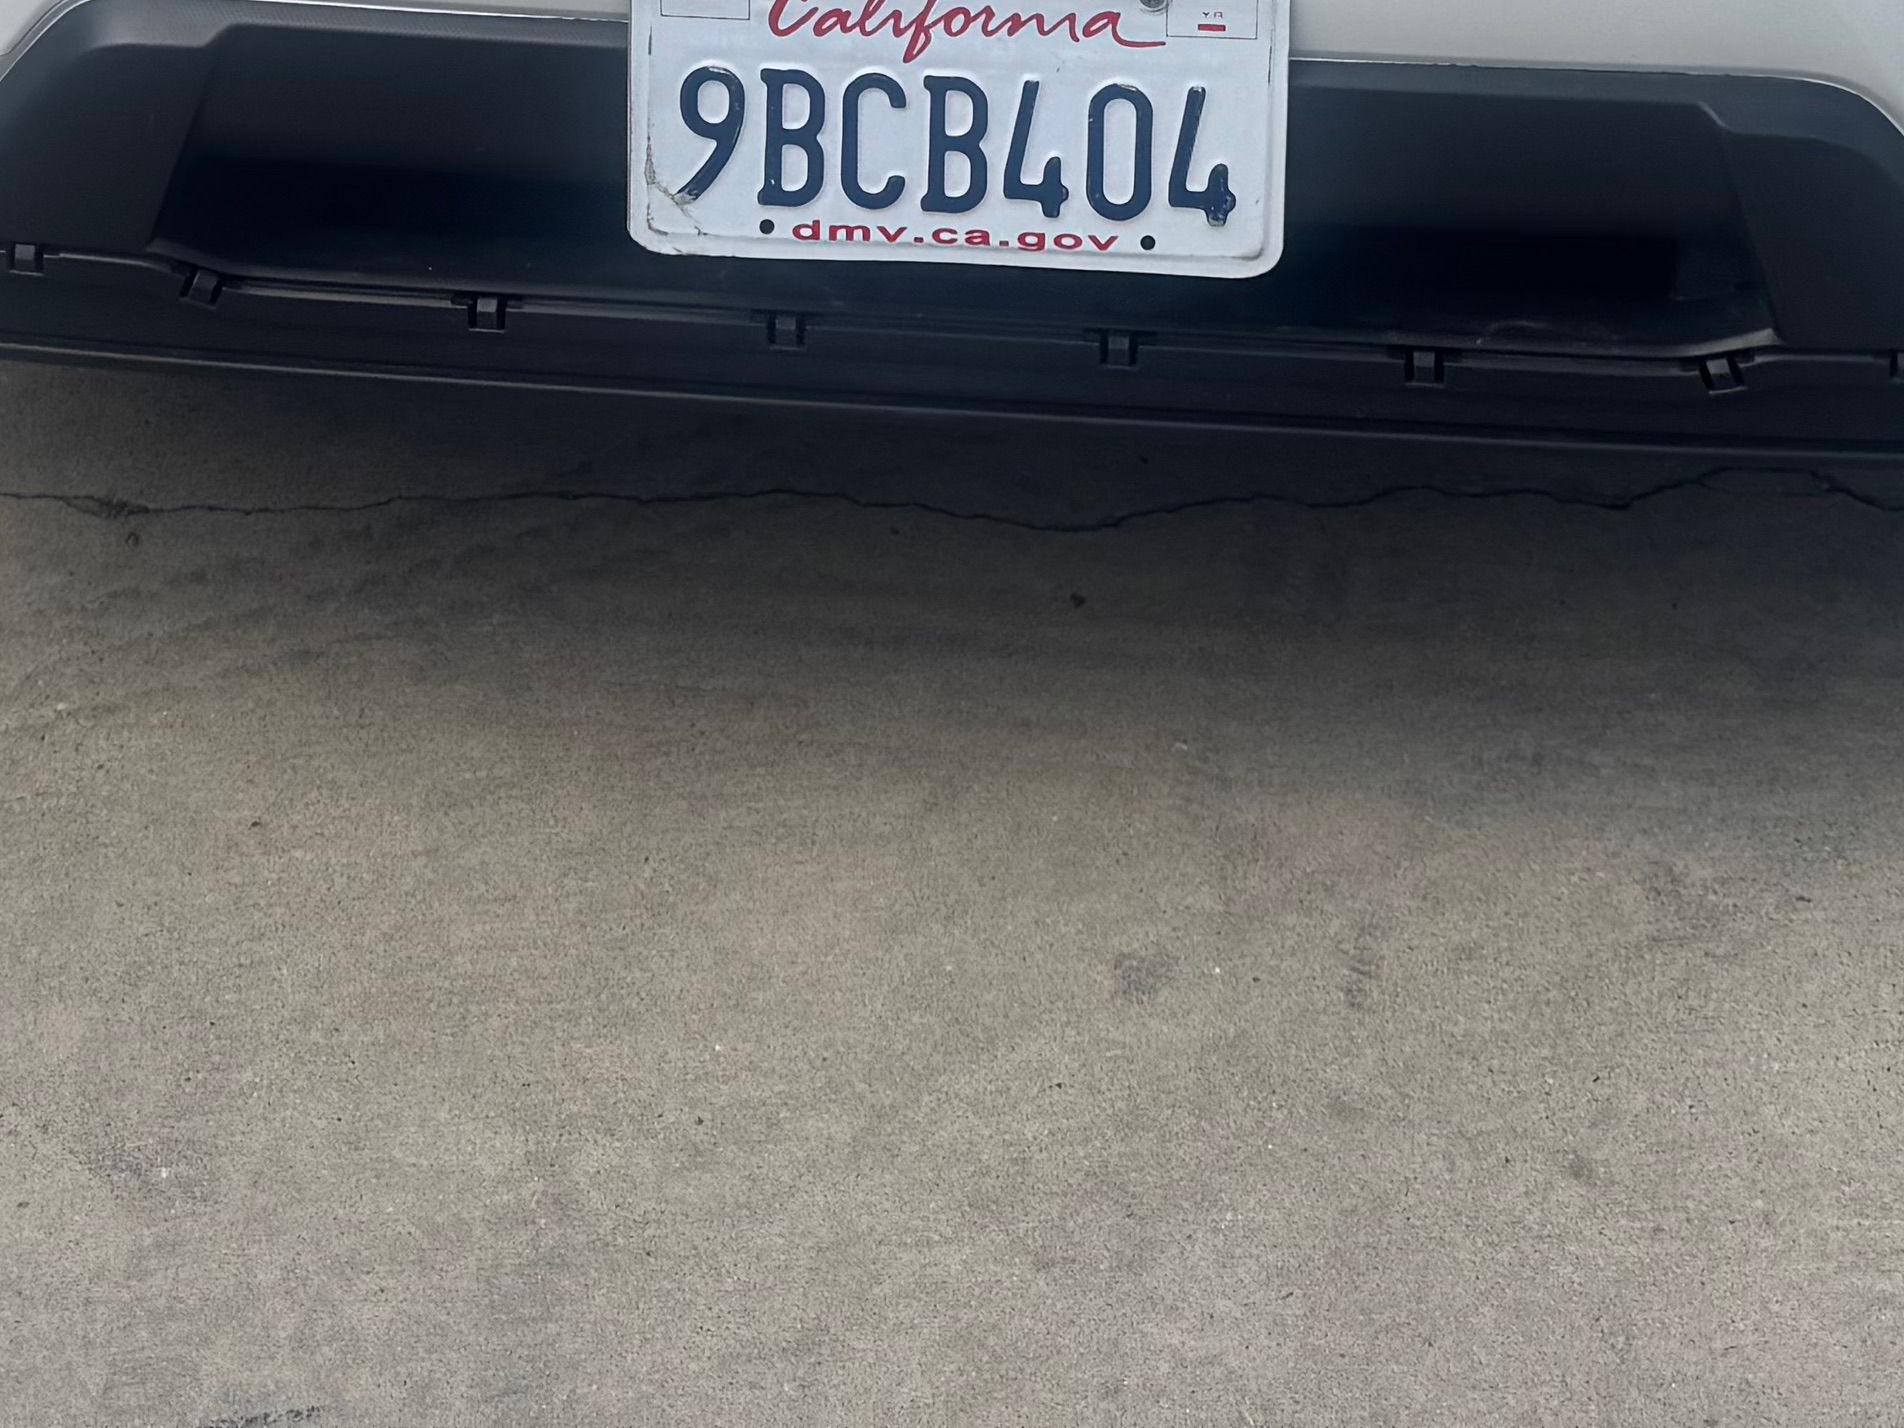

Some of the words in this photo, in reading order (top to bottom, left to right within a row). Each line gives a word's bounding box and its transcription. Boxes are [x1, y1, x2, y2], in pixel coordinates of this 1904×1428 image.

[1202, 11, 1223, 19] YR
[678, 65, 1237, 227] 9BCB404
[792, 220, 1119, 252] dmv.ca.gov
